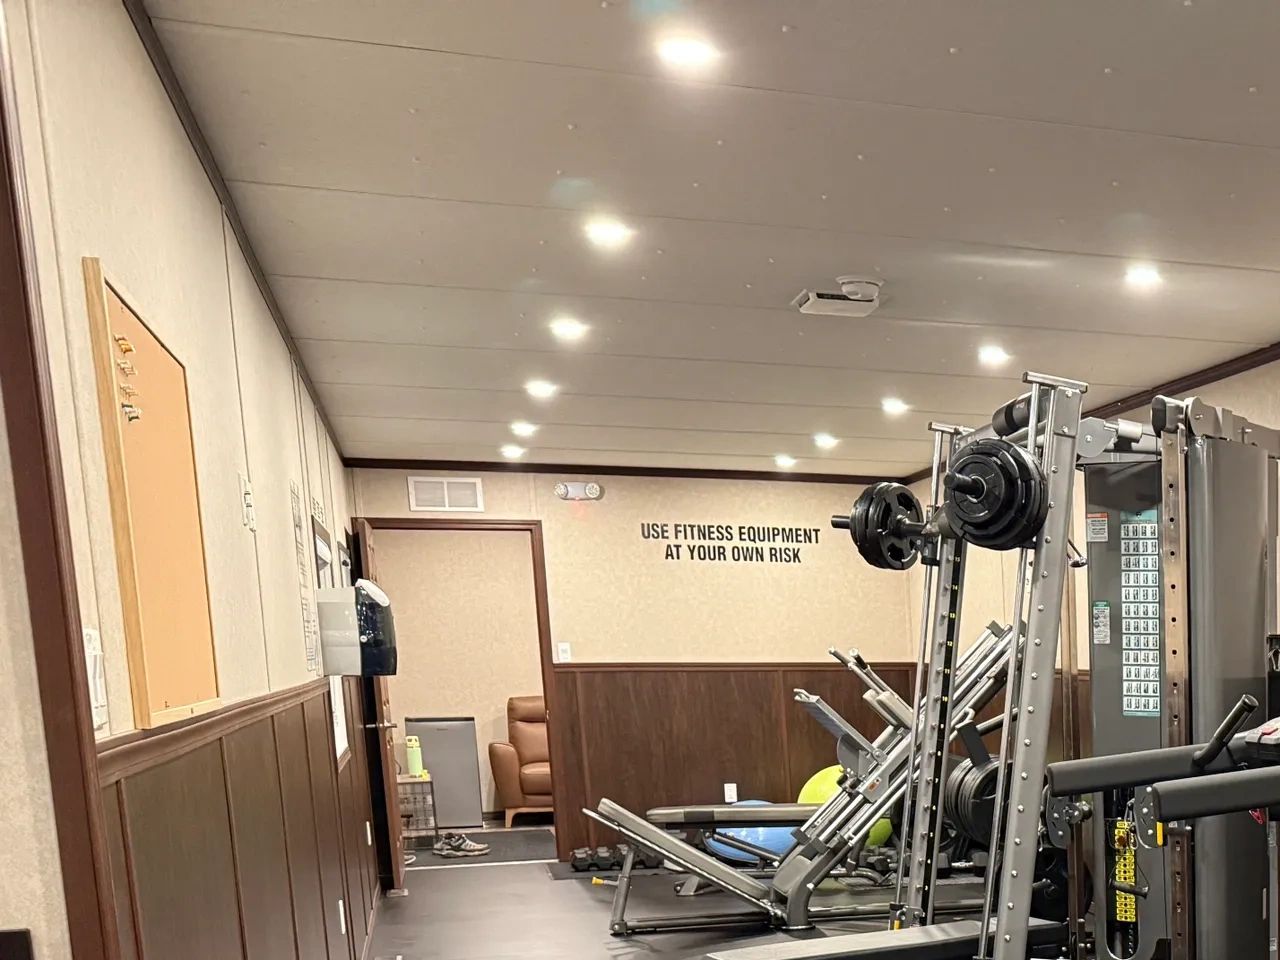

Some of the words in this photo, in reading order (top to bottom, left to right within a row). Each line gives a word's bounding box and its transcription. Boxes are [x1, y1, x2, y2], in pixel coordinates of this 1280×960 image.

[641, 522, 669, 540] USE
[674, 523, 734, 542] FITNESS
[738, 525, 821, 544] EQUIPMENT
[664, 544, 682, 560] AT
[687, 544, 727, 562] YOUR
[731, 546, 764, 562] OWN
[769, 547, 802, 563] RISK
